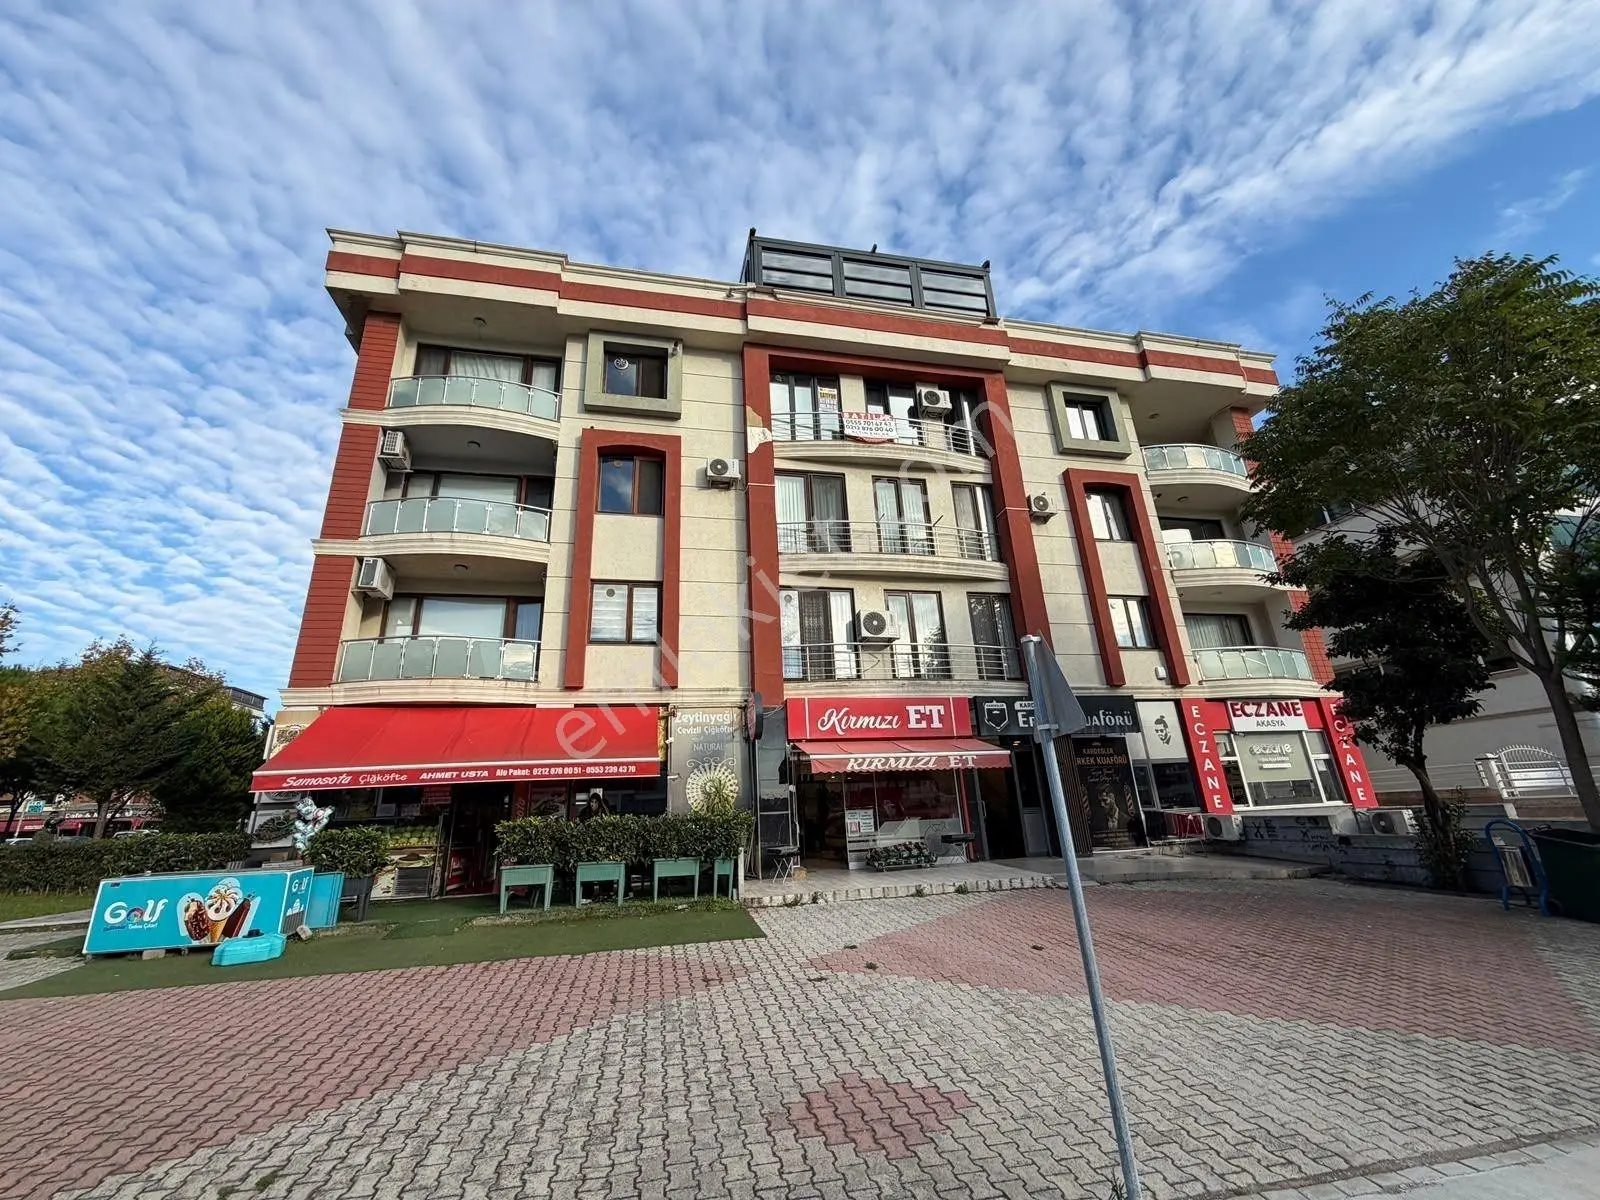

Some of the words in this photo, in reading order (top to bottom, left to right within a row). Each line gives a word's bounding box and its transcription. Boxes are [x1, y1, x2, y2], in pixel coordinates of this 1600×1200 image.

[905, 704, 945, 729] ET
[1229, 701, 1303, 717] ECZANE
[1256, 719, 1286, 727] AKASYA
[693, 742, 724, 752] NATURAL
[846, 755, 938, 771] KIRMIZI
[949, 754, 978, 769] ET
[1190, 705, 1224, 809] ECZANE
[282, 772, 352, 787] Samosota
[419, 771, 458, 780] AHMET
[460, 770, 489, 778] USTA
[532, 767, 550, 776] 0212
[586, 766, 604, 774] 0553
[103, 898, 169, 924] Golf
